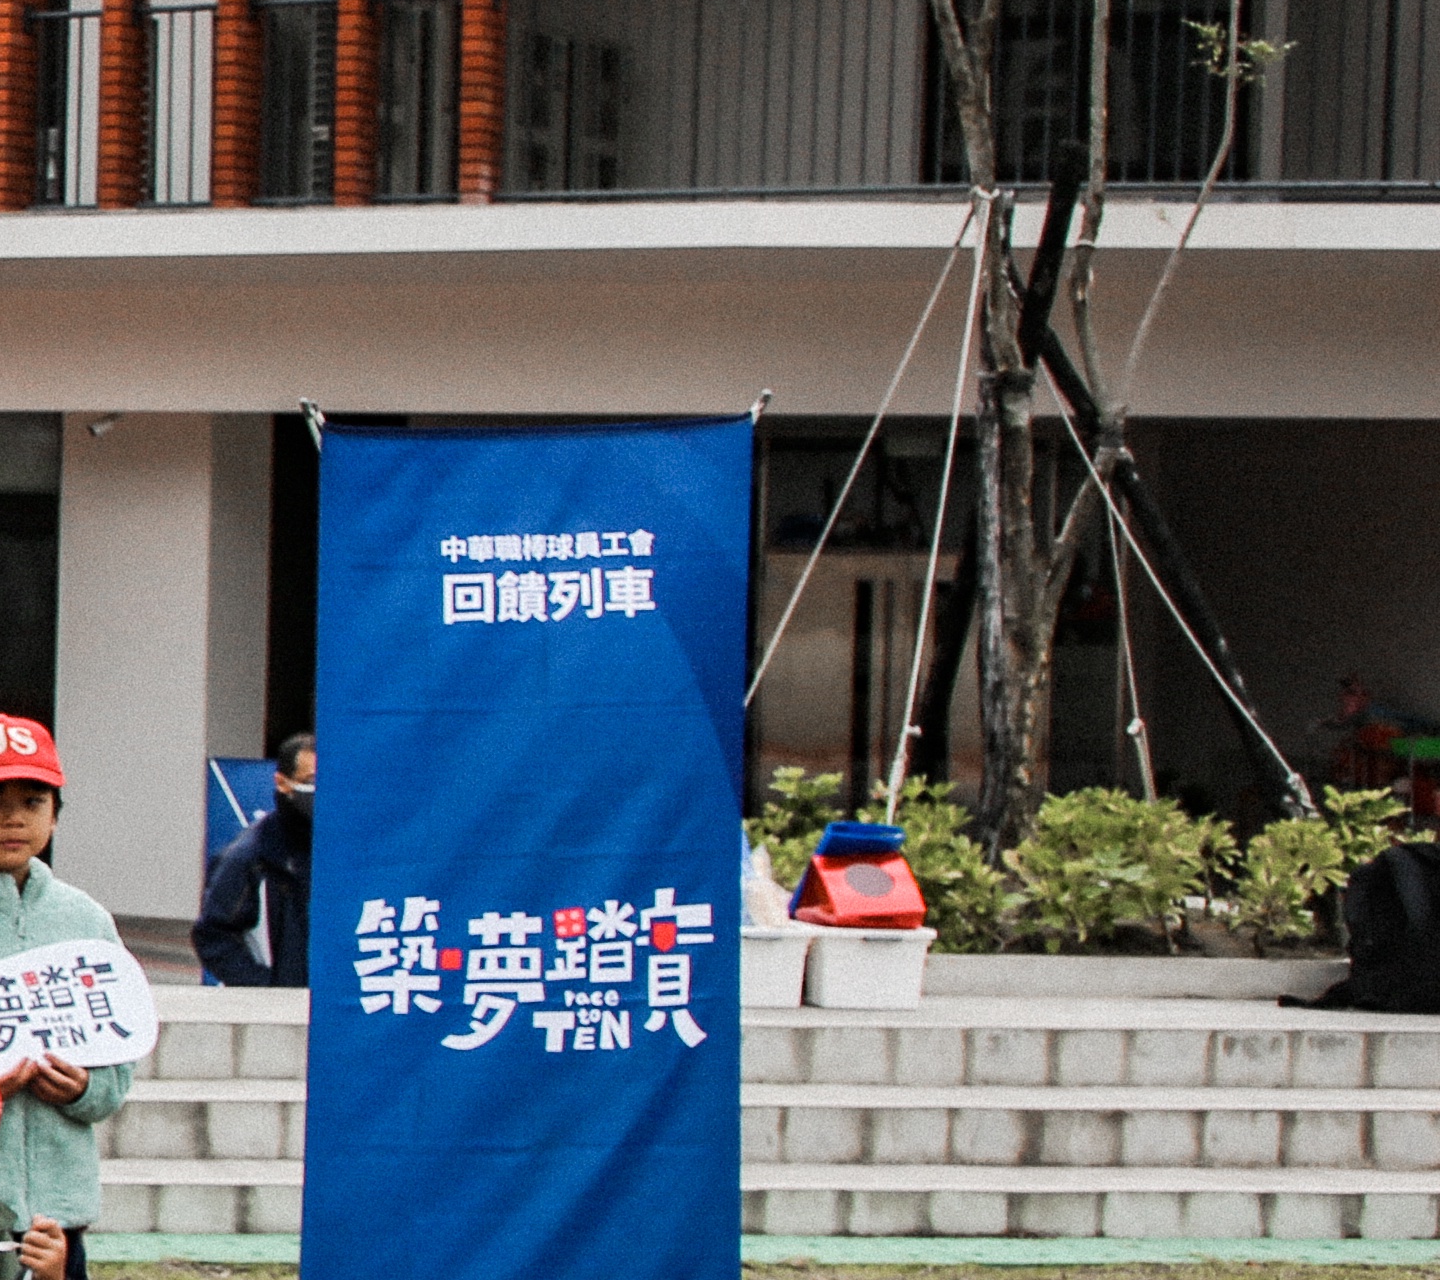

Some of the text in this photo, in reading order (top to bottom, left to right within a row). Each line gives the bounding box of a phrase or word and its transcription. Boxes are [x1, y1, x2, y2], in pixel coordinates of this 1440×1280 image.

[440, 528, 655, 563] 中華職棒球員工會
[442, 566, 656, 626] 回饋列車
[532, 1009, 631, 1053] TEN
